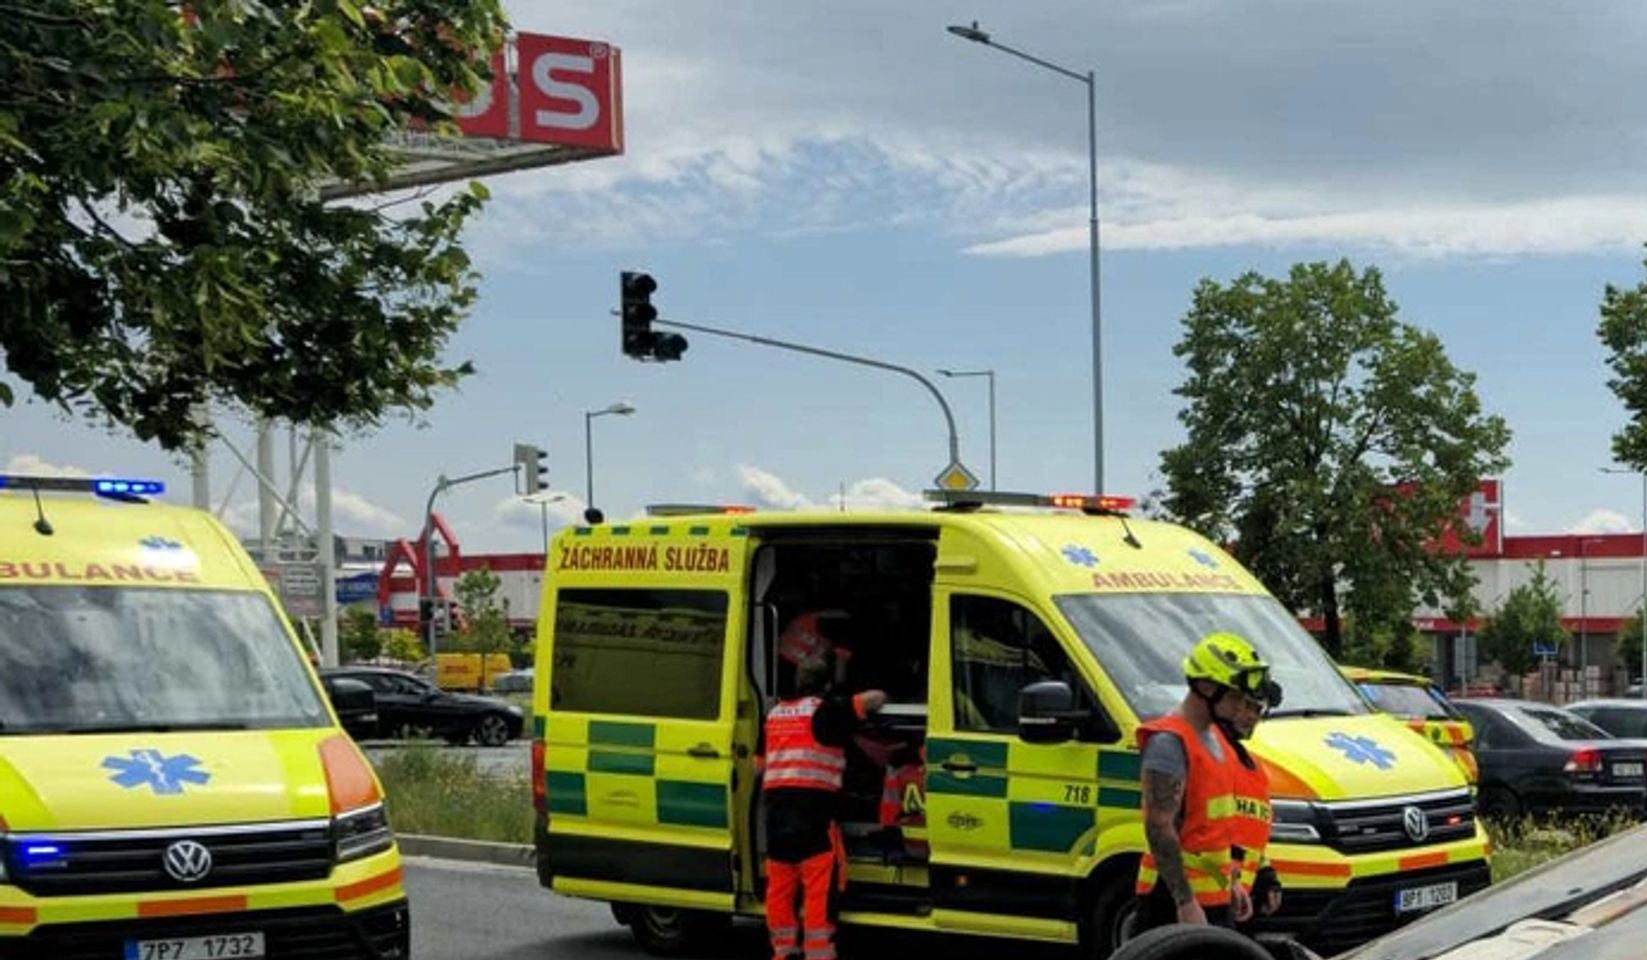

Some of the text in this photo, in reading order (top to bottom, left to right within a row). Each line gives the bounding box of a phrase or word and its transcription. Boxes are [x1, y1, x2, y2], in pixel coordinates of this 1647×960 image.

[560, 541, 729, 572] ZÁCHRANNÁ SLUŽBA
[1093, 571, 1243, 589] AMBULANCE
[1064, 785, 1091, 803] 718
[203, 935, 255, 957] 1732
